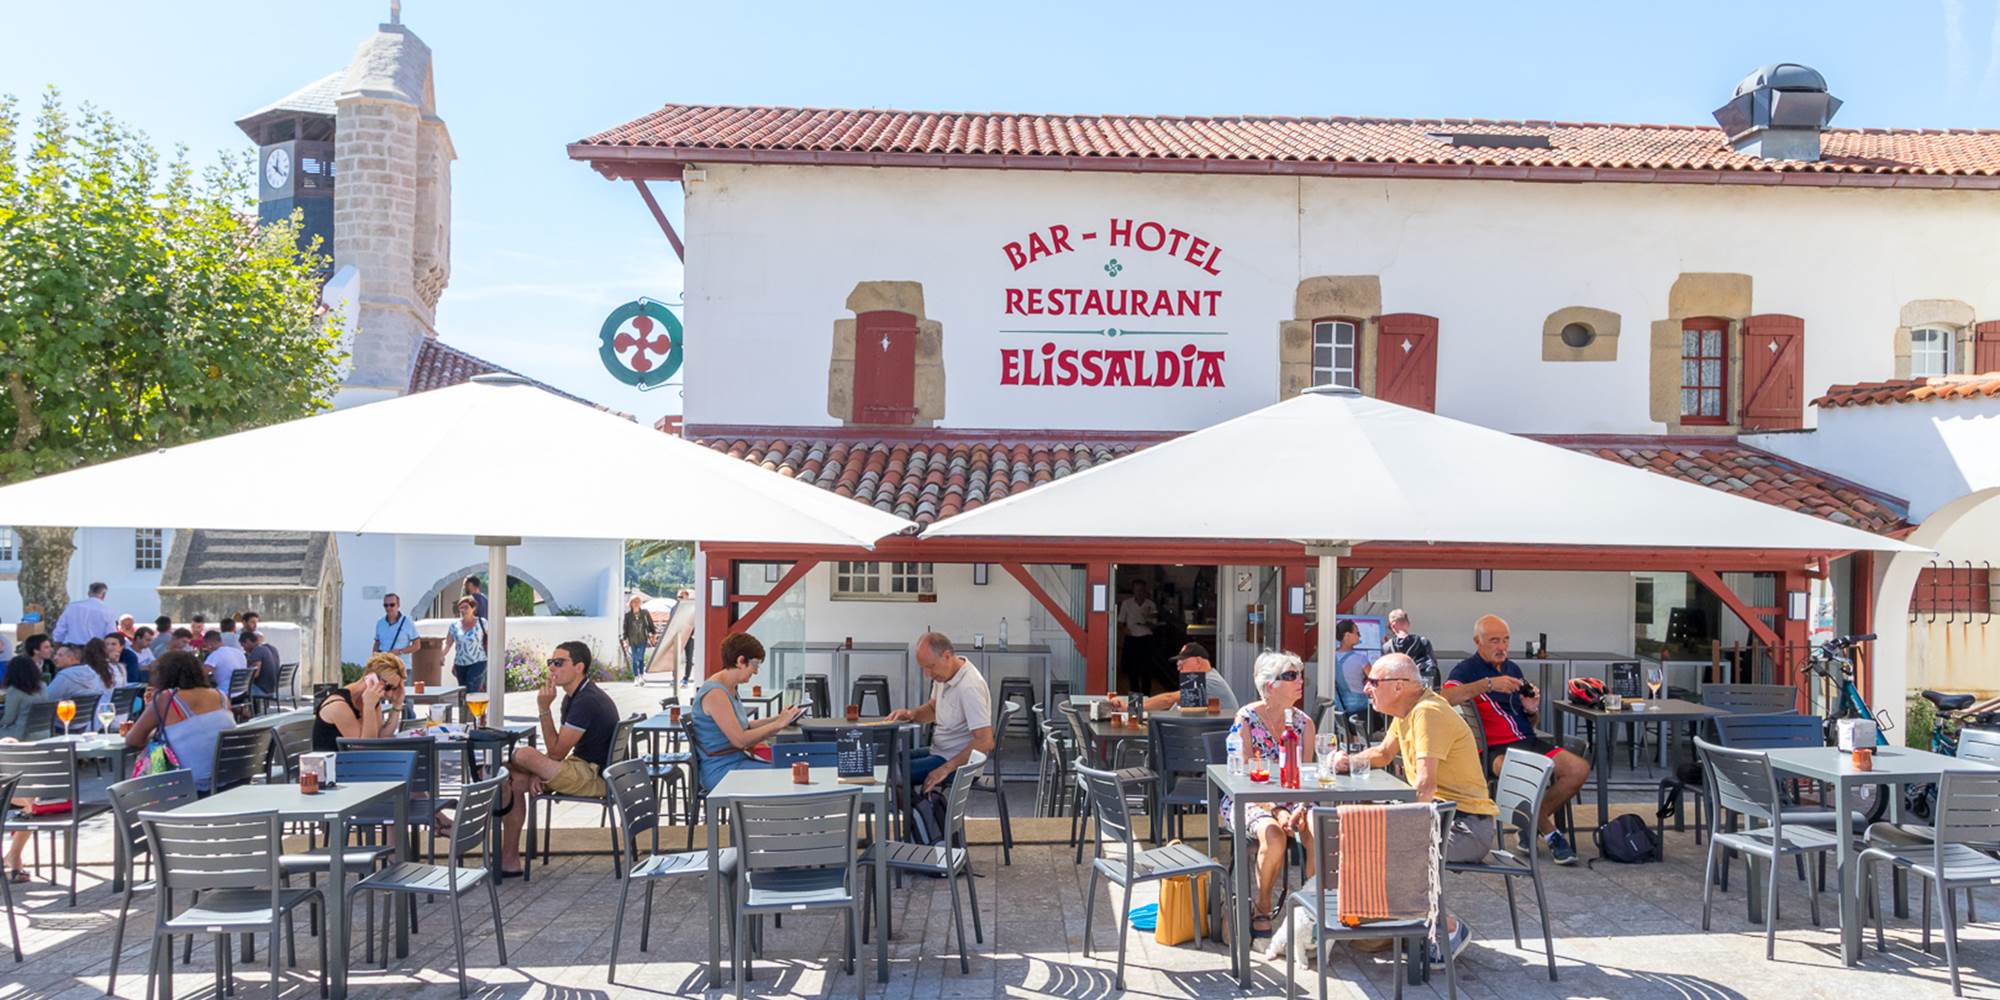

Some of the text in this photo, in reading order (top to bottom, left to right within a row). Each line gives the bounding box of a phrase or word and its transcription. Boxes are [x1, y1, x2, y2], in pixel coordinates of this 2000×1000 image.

[1002, 224, 1075, 271] BAR
[1110, 218, 1222, 276] HOTEL
[1004, 288, 1222, 317] RESTAURANT
